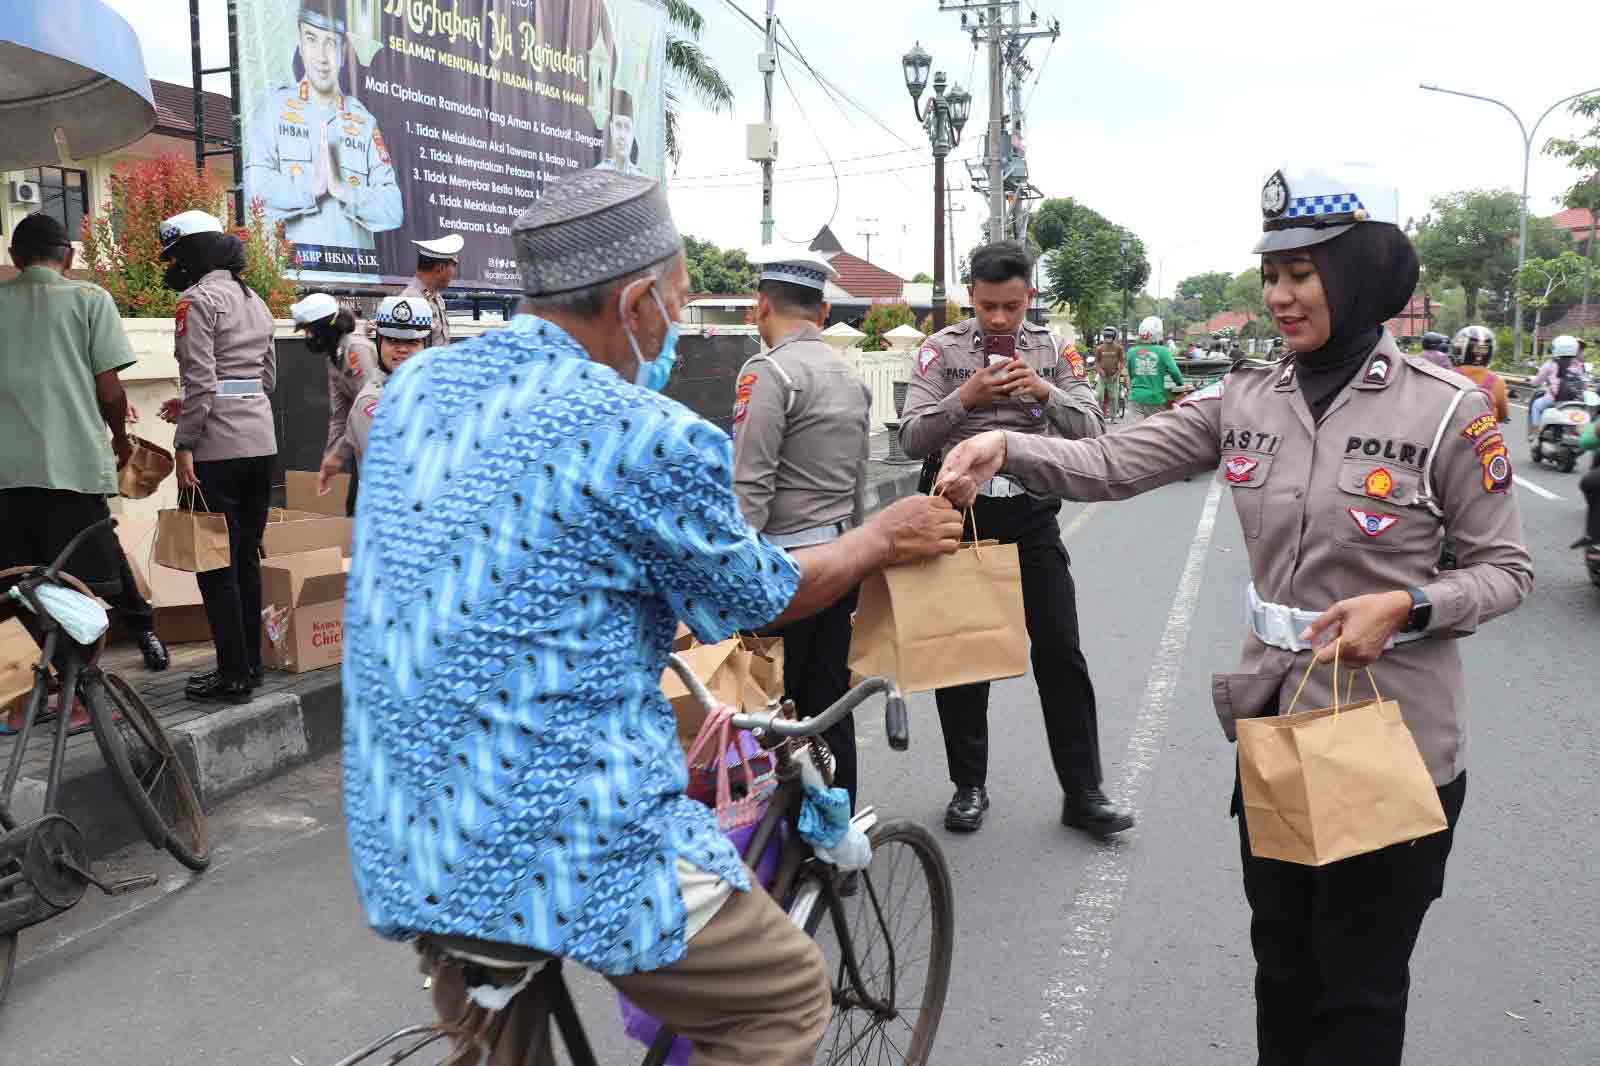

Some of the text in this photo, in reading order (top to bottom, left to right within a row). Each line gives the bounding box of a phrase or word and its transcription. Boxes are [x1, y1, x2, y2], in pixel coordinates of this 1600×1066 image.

[487, 10, 514, 60] Ya
[388, 35, 436, 62] SELAMAT
[437, 50, 500, 83] MENUNAIKAN
[502, 71, 533, 92] IBADAH
[535, 81, 561, 99] PUASA
[365, 75, 389, 94] Mari
[390, 83, 437, 107] Ciptakan
[438, 96, 483, 119] Ramadan
[483, 106, 507, 127] Yang
[507, 114, 532, 132] Aman
[533, 122, 539, 133] &
[405, 120, 414, 134] 1.
[416, 123, 440, 139] Tidak
[442, 129, 488, 150] Melakukan
[489, 140, 505, 154] Aksi
[506, 143, 538, 160] Tawuran
[538, 151, 545, 162] &
[419, 146, 428, 159] 2.
[430, 148, 453, 164] Tidak
[413, 167, 422, 181] 3.
[423, 169, 448, 185] Tidak
[449, 174, 490, 192] Menyebar
[514, 185, 536, 200] Hoax
[429, 192, 438, 206] 4.
[439, 194, 462, 209] Tidak
[463, 198, 507, 215] Melakukan
[439, 216, 485, 233] Kendaraan
[486, 223, 493, 234] &
[1344, 434, 1430, 469] POLRI
